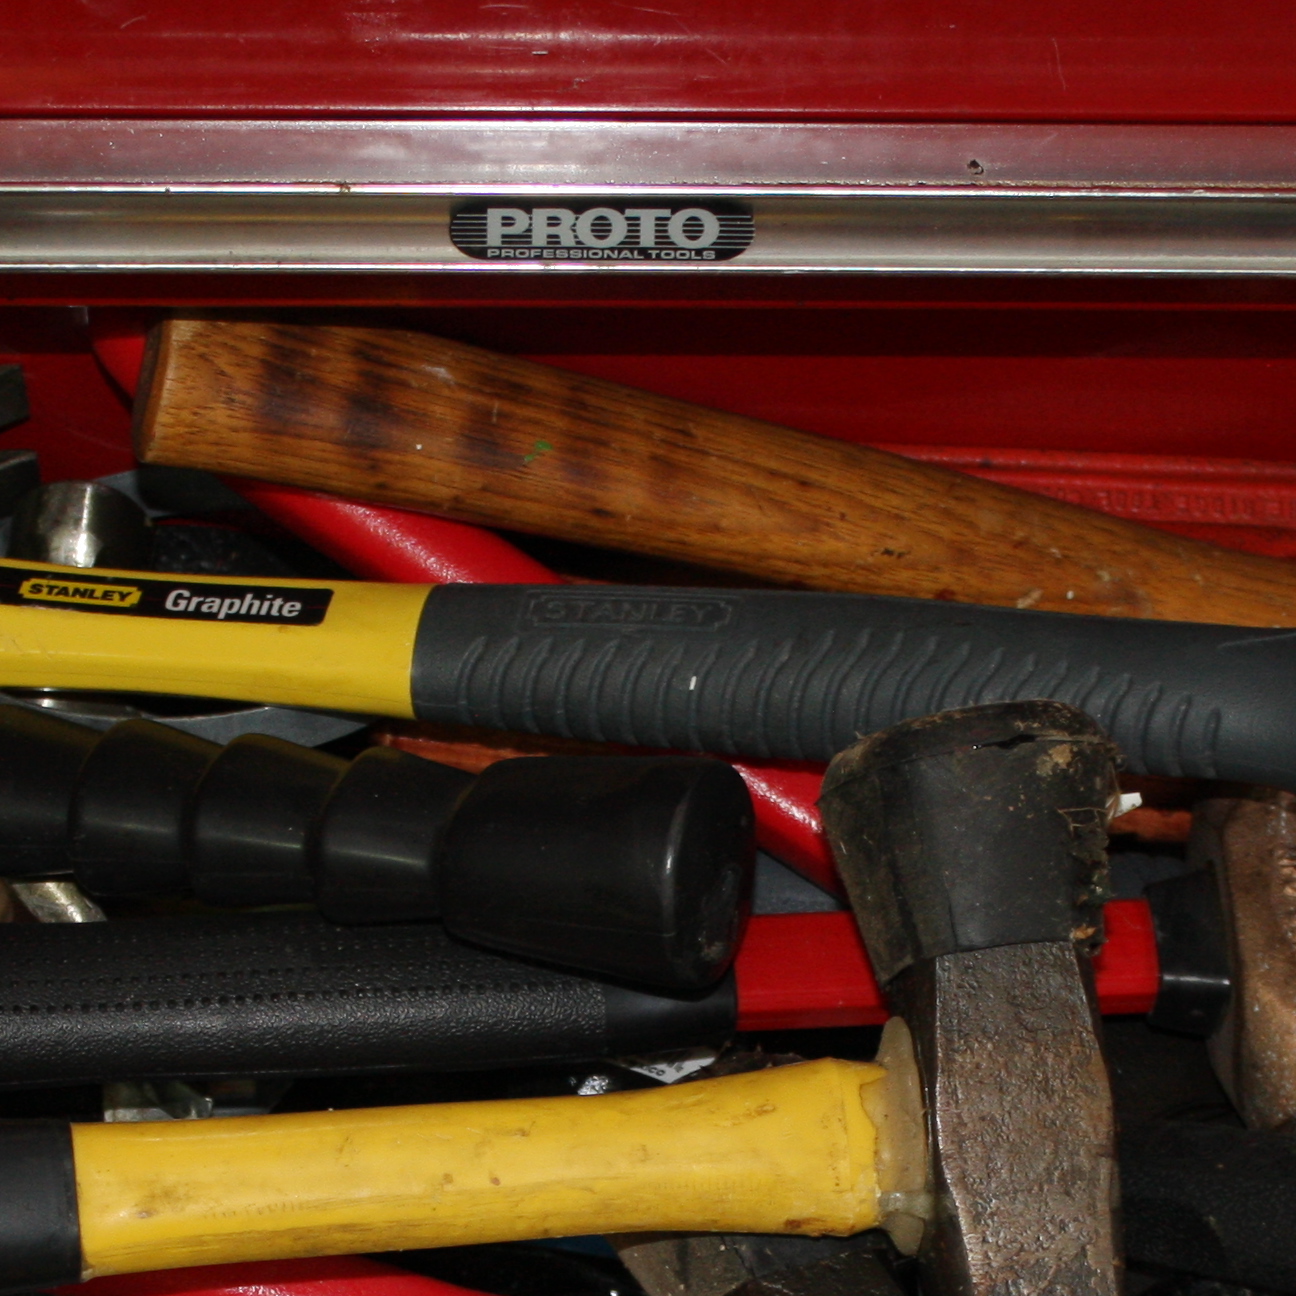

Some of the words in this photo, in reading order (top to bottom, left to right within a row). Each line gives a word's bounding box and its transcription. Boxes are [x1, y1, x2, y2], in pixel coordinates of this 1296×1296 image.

[486, 207, 720, 249] PROTO
[486, 248, 644, 260] PROFESSIONAL
[647, 249, 716, 260] TOOLS
[28, 582, 135, 603] STANLEY
[165, 589, 302, 620] Graphite
[545, 600, 719, 626] STANLEY
